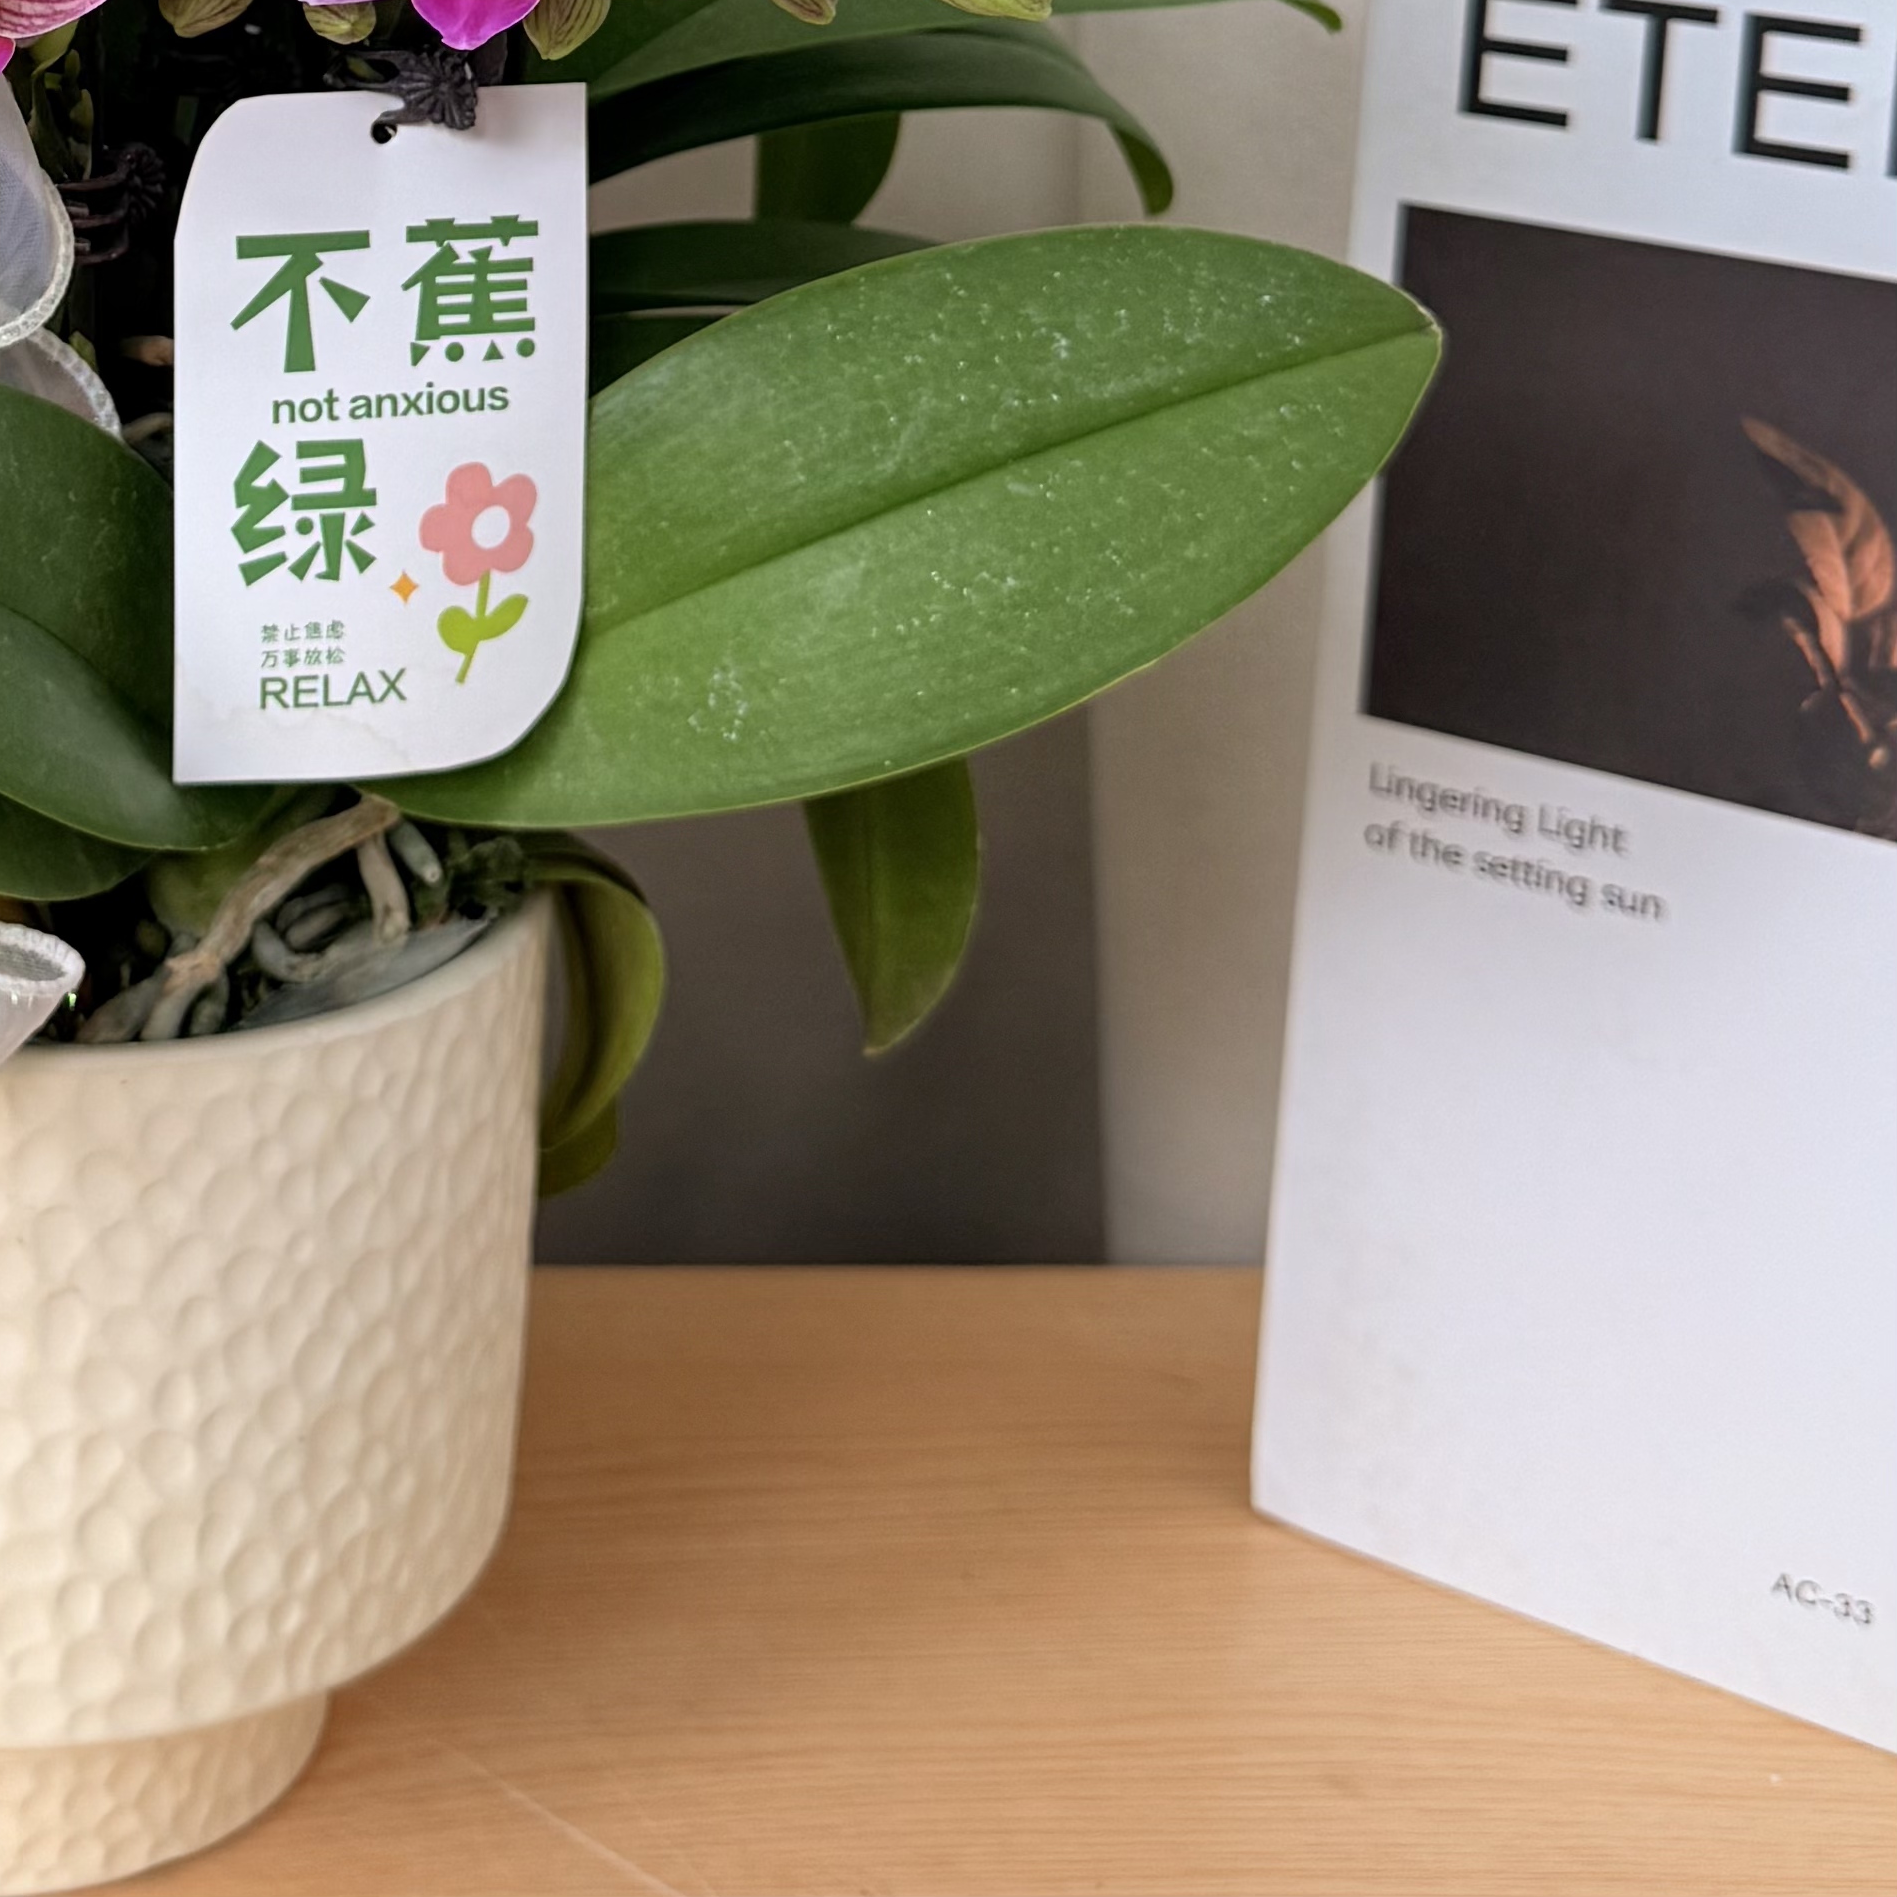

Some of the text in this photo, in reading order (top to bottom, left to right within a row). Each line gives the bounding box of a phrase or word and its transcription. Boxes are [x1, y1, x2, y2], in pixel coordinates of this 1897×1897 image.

[231, 215, 539, 373] 不蕉
[272, 381, 510, 424] not anxious
[231, 440, 378, 587] 绿
[259, 668, 407, 710] RELAX
[261, 646, 345, 668] 万事放松
[1367, 760, 1629, 853] Lingering Light
[1363, 819, 1665, 920] of the setting sun
[1770, 1572, 1876, 1626] AC-33
